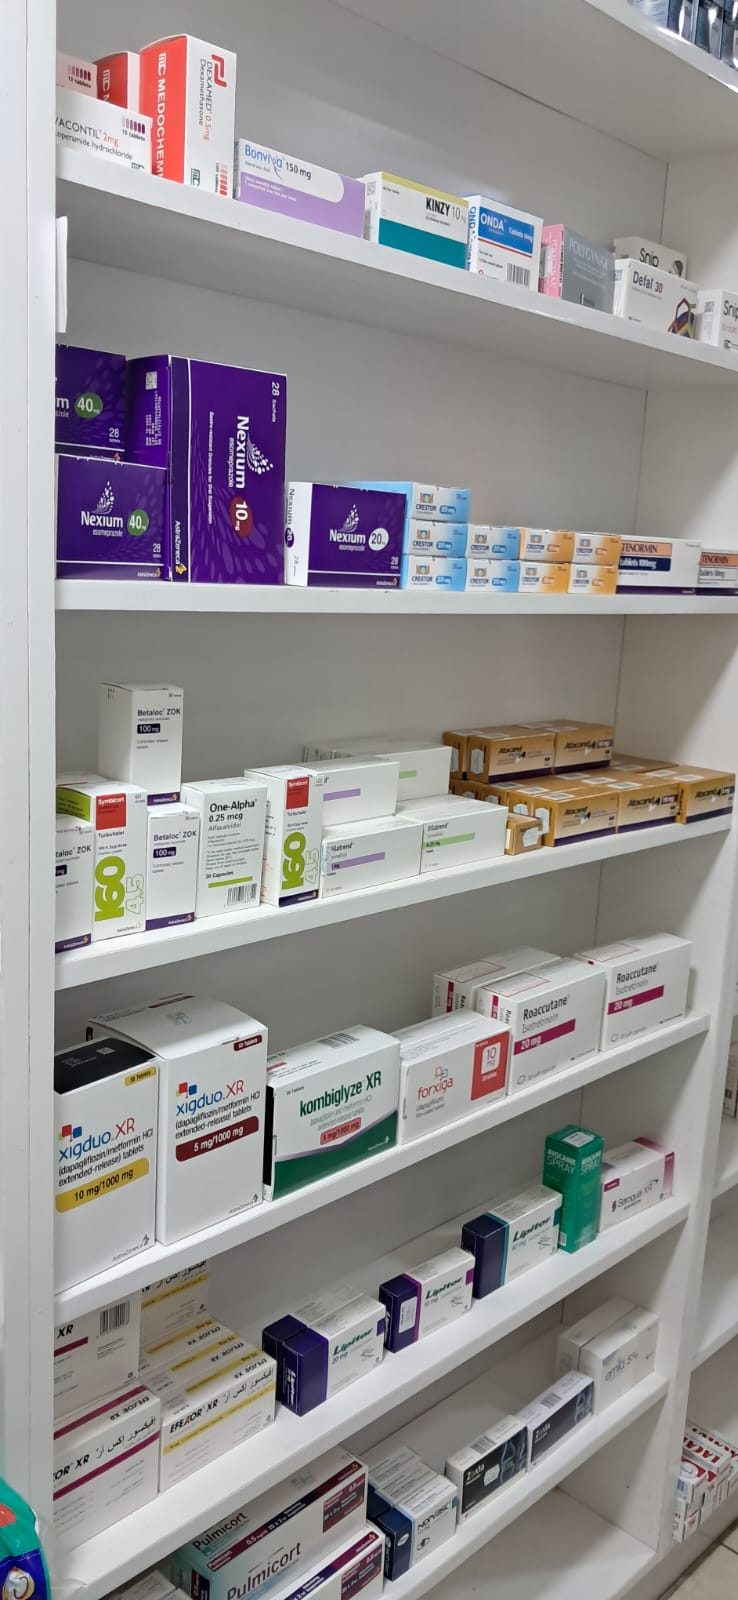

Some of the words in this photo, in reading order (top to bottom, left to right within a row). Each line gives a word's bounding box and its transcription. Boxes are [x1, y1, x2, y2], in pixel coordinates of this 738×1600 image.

[92, 140, 132, 160] hydrochloride
[102, 132, 119, 148] 2mg
[244, 144, 283, 169] Bonviva
[286, 162, 298, 174] 150
[300, 168, 312, 180] mg
[425, 196, 451, 216] KINZY
[451, 206, 461, 220] 10
[480, 213, 505, 231] ONDA
[632, 271, 654, 290] Defal
[655, 281, 663, 293] 30
[272, 382, 280, 396] 28
[109, 428, 120, 438] 28
[236, 415, 249, 489] Nexium
[81, 511, 123, 528] Nexium
[330, 529, 366, 544] Nexium
[153, 543, 161, 553] 28
[622, 543, 657, 553] TENORMIN
[138, 709, 163, 717] Betaloc
[98, 796, 125, 806] Symbicort
[210, 800, 256, 813] One-Alpha
[209, 813, 225, 823] 0.25
[227, 812, 243, 821] mcg
[153, 833, 179, 842] Betaloc
[56, 848, 73, 858] taloc
[76, 845, 91, 854] ZOK
[282, 832, 306, 890] 160
[95, 856, 126, 922] 160
[616, 965, 657, 983] Roaccutane
[523, 996, 568, 1021] Roaccutane
[614, 1001, 622, 1010] 20
[623, 999, 632, 1008] mg
[522, 1012, 558, 1034] Isotretinoin
[521, 1040, 529, 1050] 20
[530, 1036, 542, 1046] mg
[487, 1047, 497, 1060] 10
[176, 1091, 223, 1116] xigduo
[226, 1080, 244, 1098] XR
[300, 1082, 362, 1117] kombiglyze
[366, 1071, 381, 1091] XR
[418, 1078, 454, 1100] forxiga
[175, 1112, 231, 1139] extended-release)
[233, 1105, 252, 1118] tablets
[351, 1121, 360, 1130] mg
[59, 1132, 112, 1162] xigduo
[114, 1117, 135, 1140] XR
[194, 1142, 199, 1151] 5
[200, 1131, 231, 1148] mg/1000
[232, 1127, 244, 1136] mg
[58, 1153, 122, 1187] extended-release)
[123, 1144, 144, 1160] tablets
[59, 1135, 141, 1177] (dapagliflozin/metformin
[546, 1157, 576, 1175] SPRAY
[74, 1191, 84, 1201] 10
[86, 1174, 120, 1196] mg/1000
[121, 1169, 133, 1180] mg
[512, 1216, 551, 1242] Lipitor
[425, 1277, 463, 1300] Lipitor
[56, 1324, 74, 1339] XR
[333, 1328, 373, 1356] Lipitor
[110, 1412, 120, 1421] XR
[170, 1408, 203, 1434] EFEXOR
[206, 1398, 218, 1412] XR
[75, 1454, 90, 1469] XR
[192, 1512, 248, 1550] Pulmicort
[226, 1542, 301, 1600] Pulmicort
